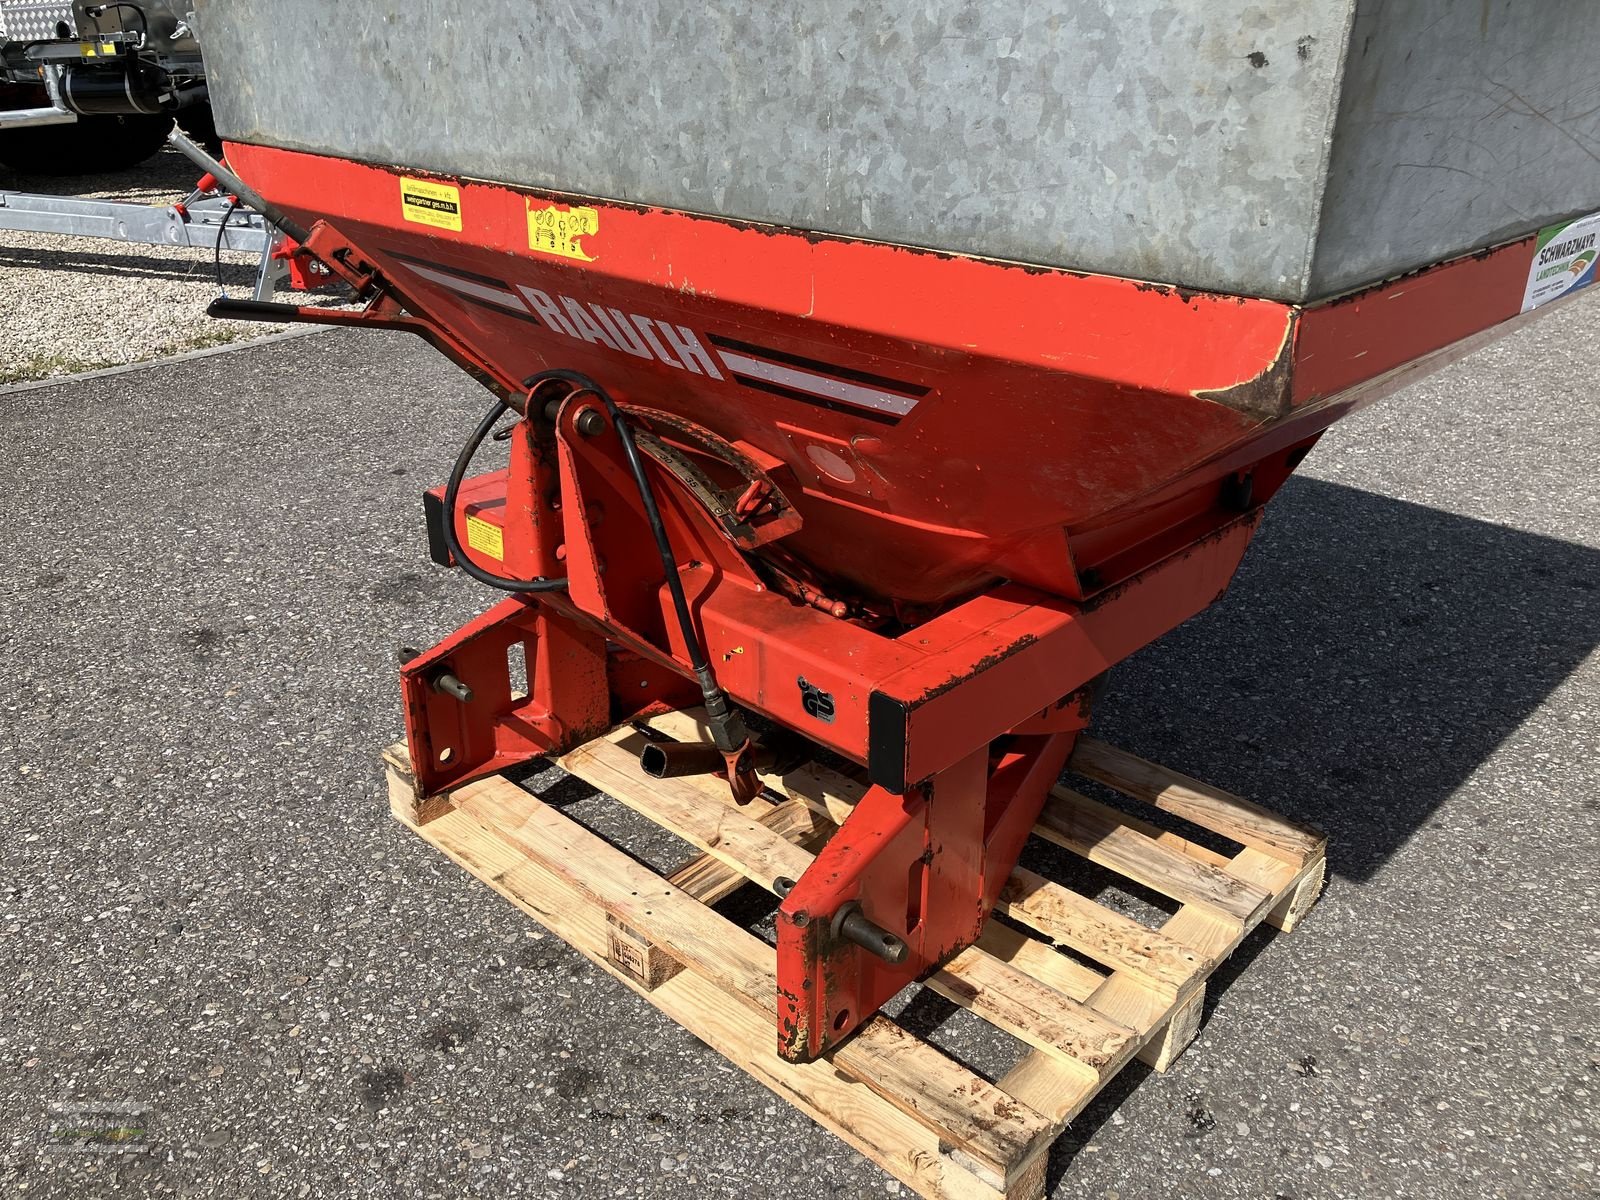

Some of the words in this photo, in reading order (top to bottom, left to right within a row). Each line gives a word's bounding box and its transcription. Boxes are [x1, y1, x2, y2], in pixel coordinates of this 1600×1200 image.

[1538, 233, 1596, 266] SCHWARZMAYR
[516, 284, 725, 382] RAUCH
[660, 454, 673, 464] 30
[685, 476, 698, 488] 35
